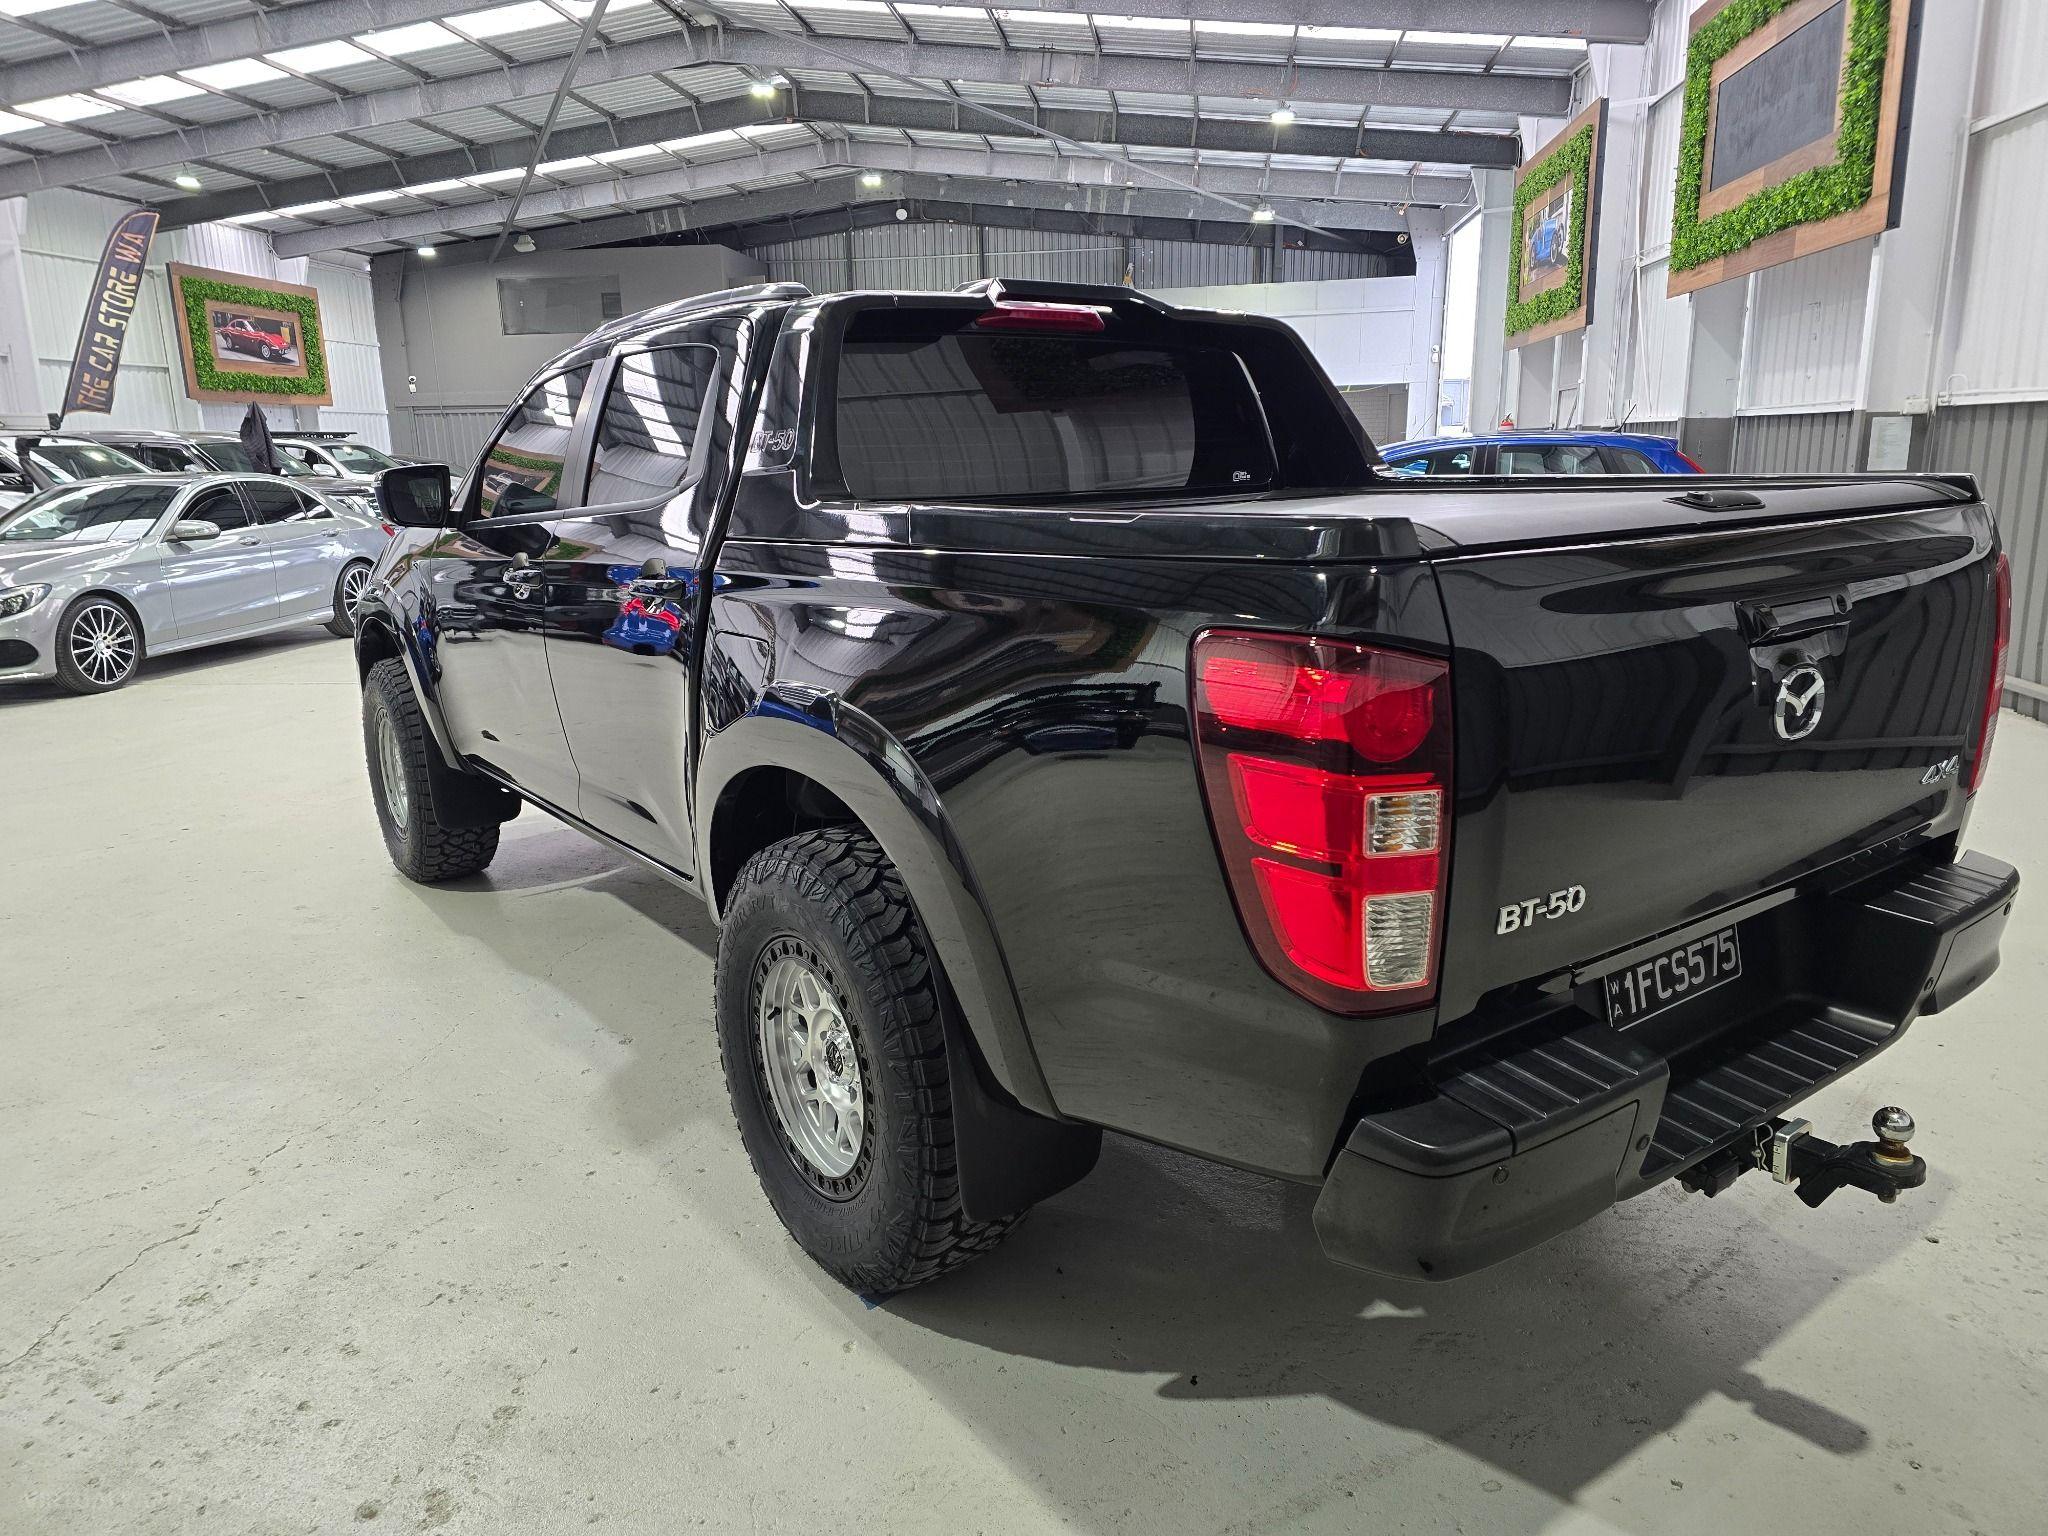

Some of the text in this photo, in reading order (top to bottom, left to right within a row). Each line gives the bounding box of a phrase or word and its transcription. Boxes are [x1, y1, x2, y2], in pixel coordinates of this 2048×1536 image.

[77, 232, 146, 409] THE CAR STORE WA
[1496, 885, 1587, 935] BT-50
[1624, 928, 1737, 1014] 1FCS575
